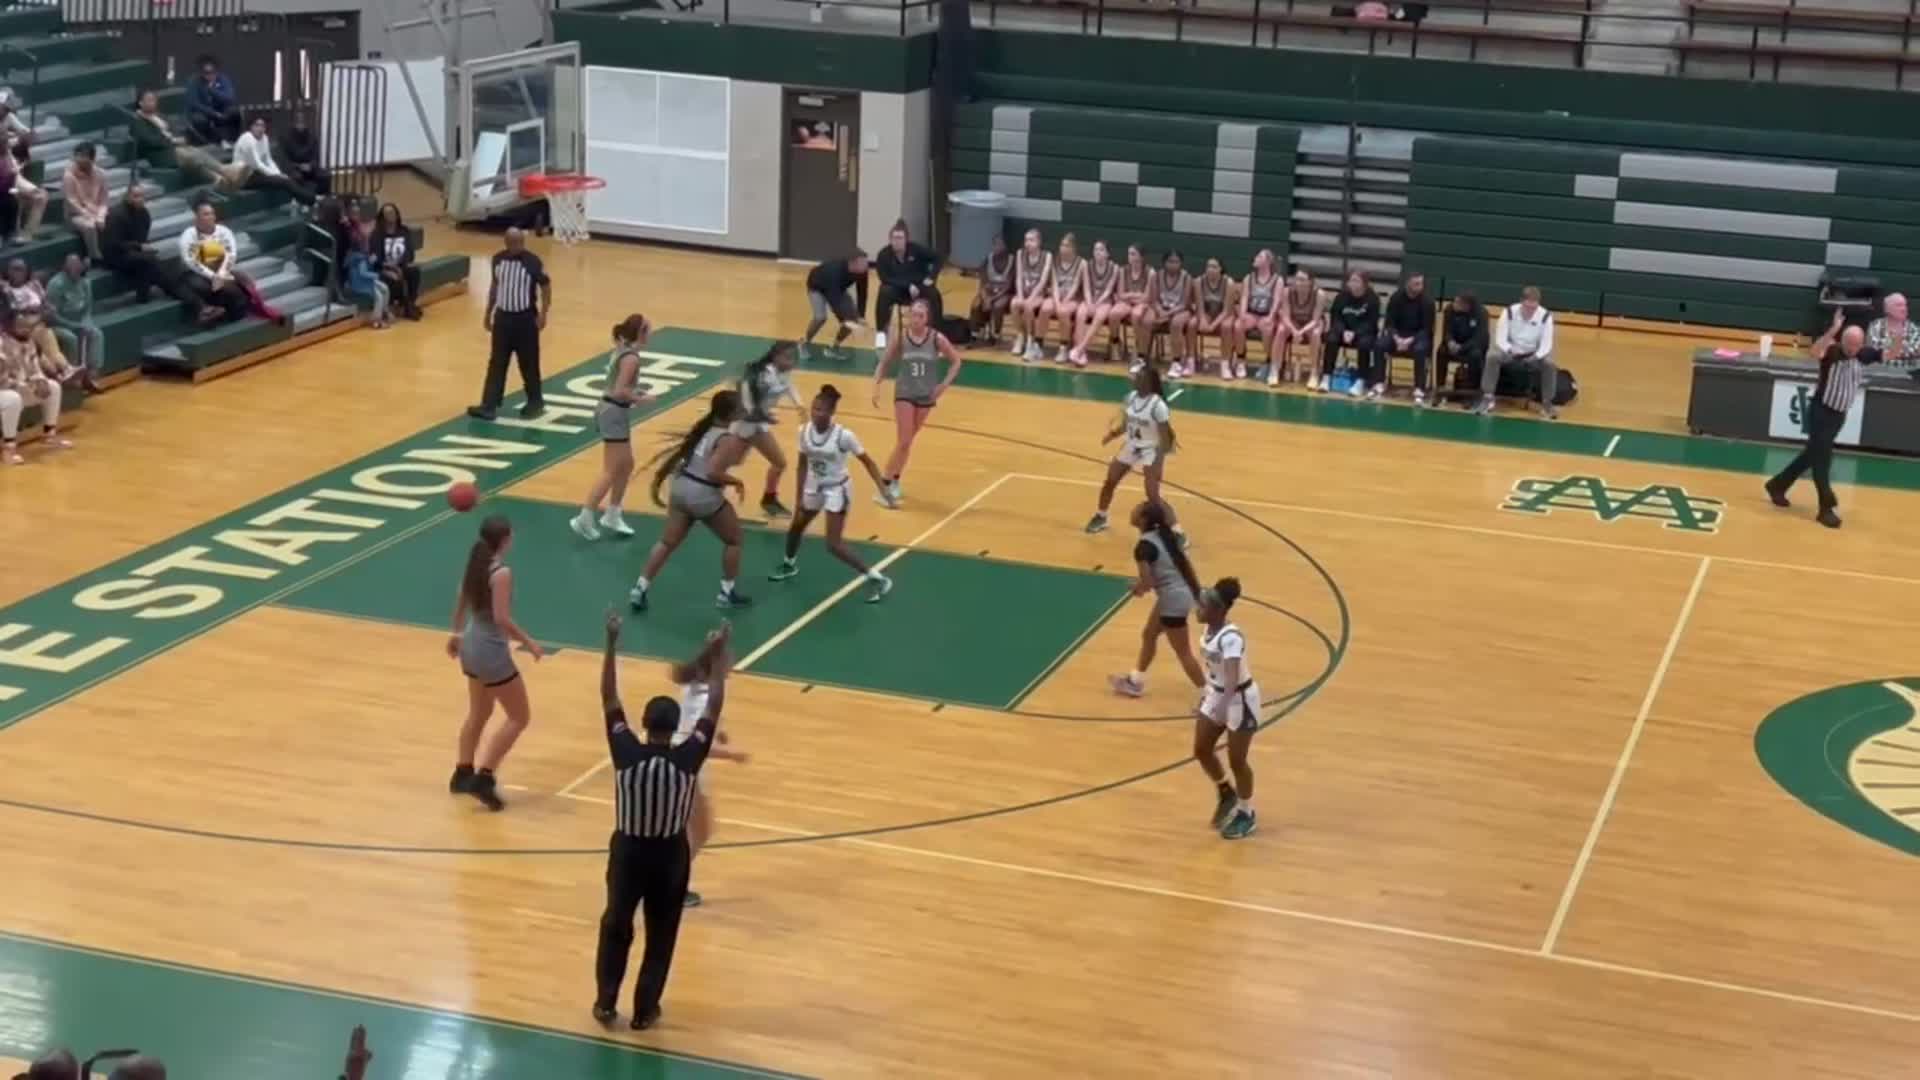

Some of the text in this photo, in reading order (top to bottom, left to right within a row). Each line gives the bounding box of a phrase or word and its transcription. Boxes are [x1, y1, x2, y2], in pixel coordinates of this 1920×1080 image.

[911, 362, 926, 377] 31
[72, 434, 546, 619] STATION
[493, 350, 726, 434] HIGH
